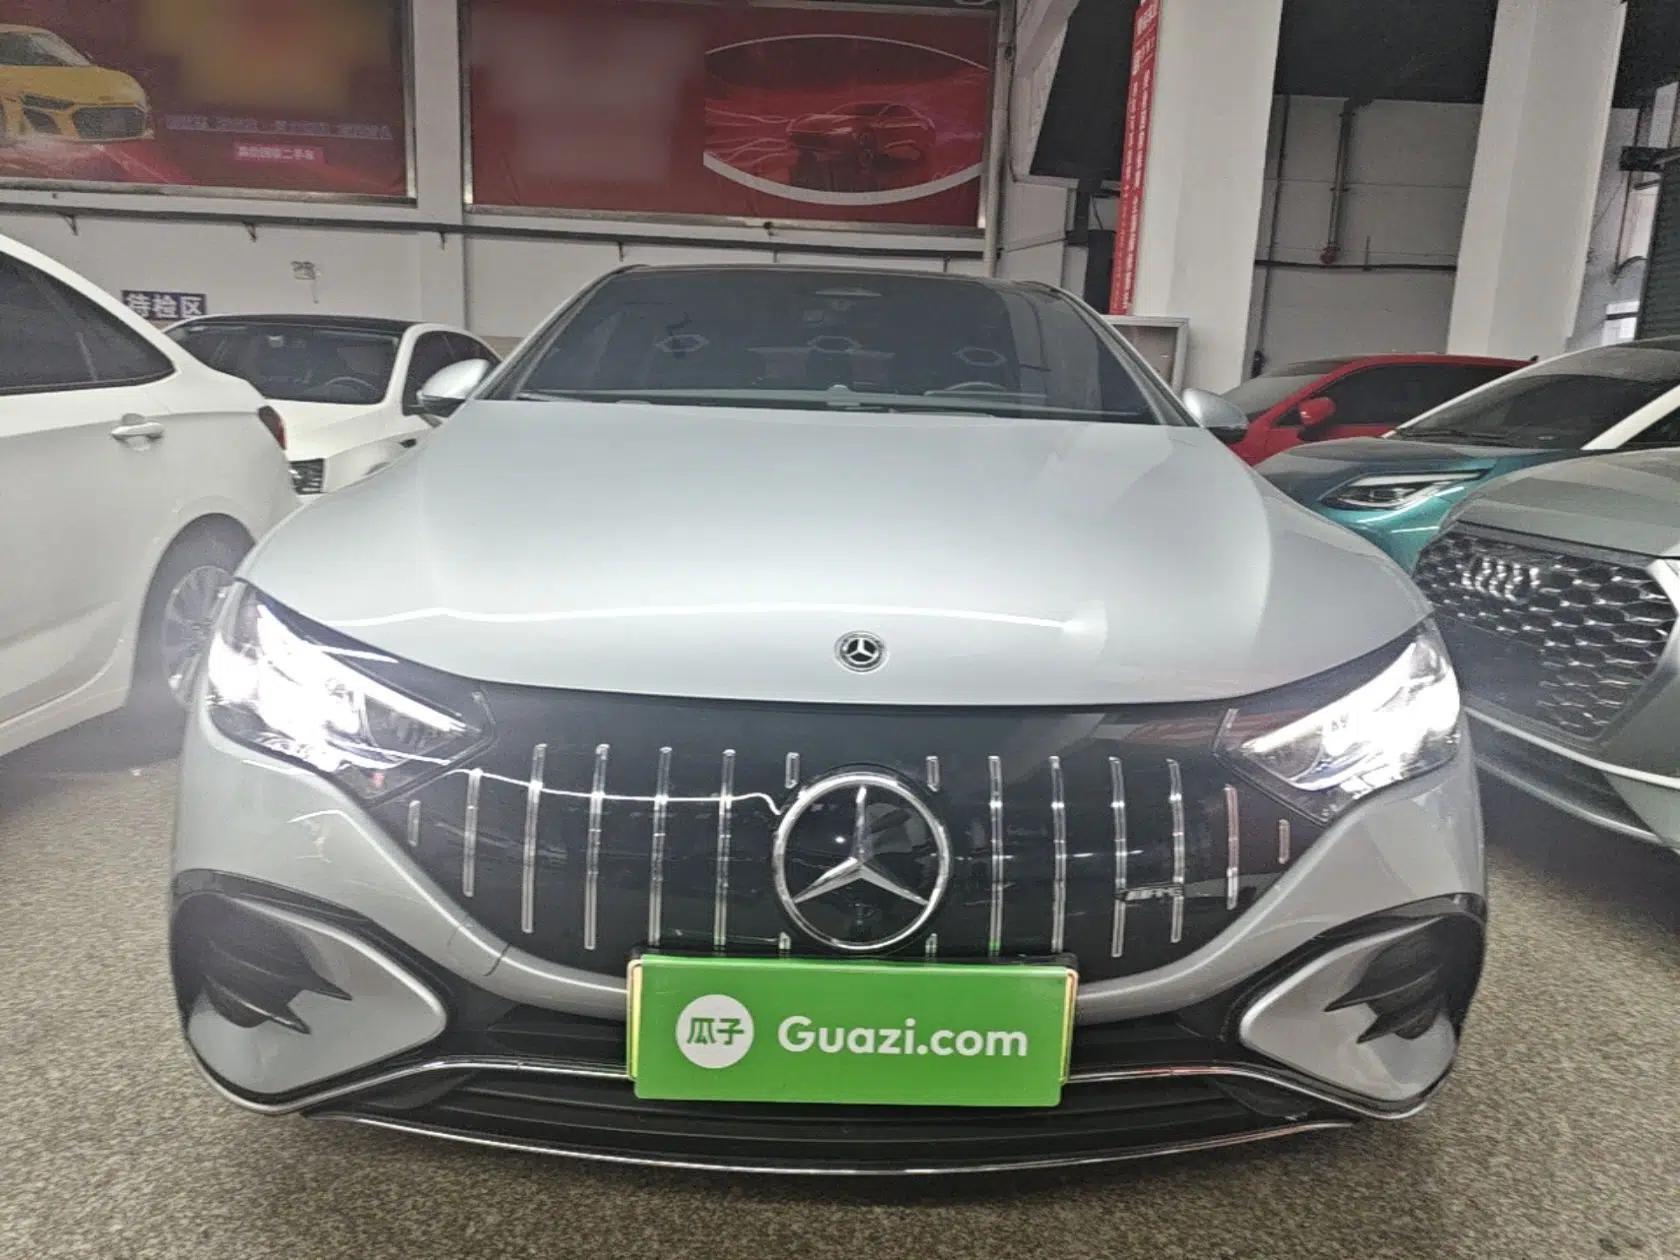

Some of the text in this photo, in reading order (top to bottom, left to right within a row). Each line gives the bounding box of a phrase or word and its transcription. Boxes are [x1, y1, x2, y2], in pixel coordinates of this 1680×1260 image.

[126, 293, 203, 319] 待检区
[687, 1018, 744, 1045] 瓜子
[778, 1015, 1028, 1056] Guazi.com
